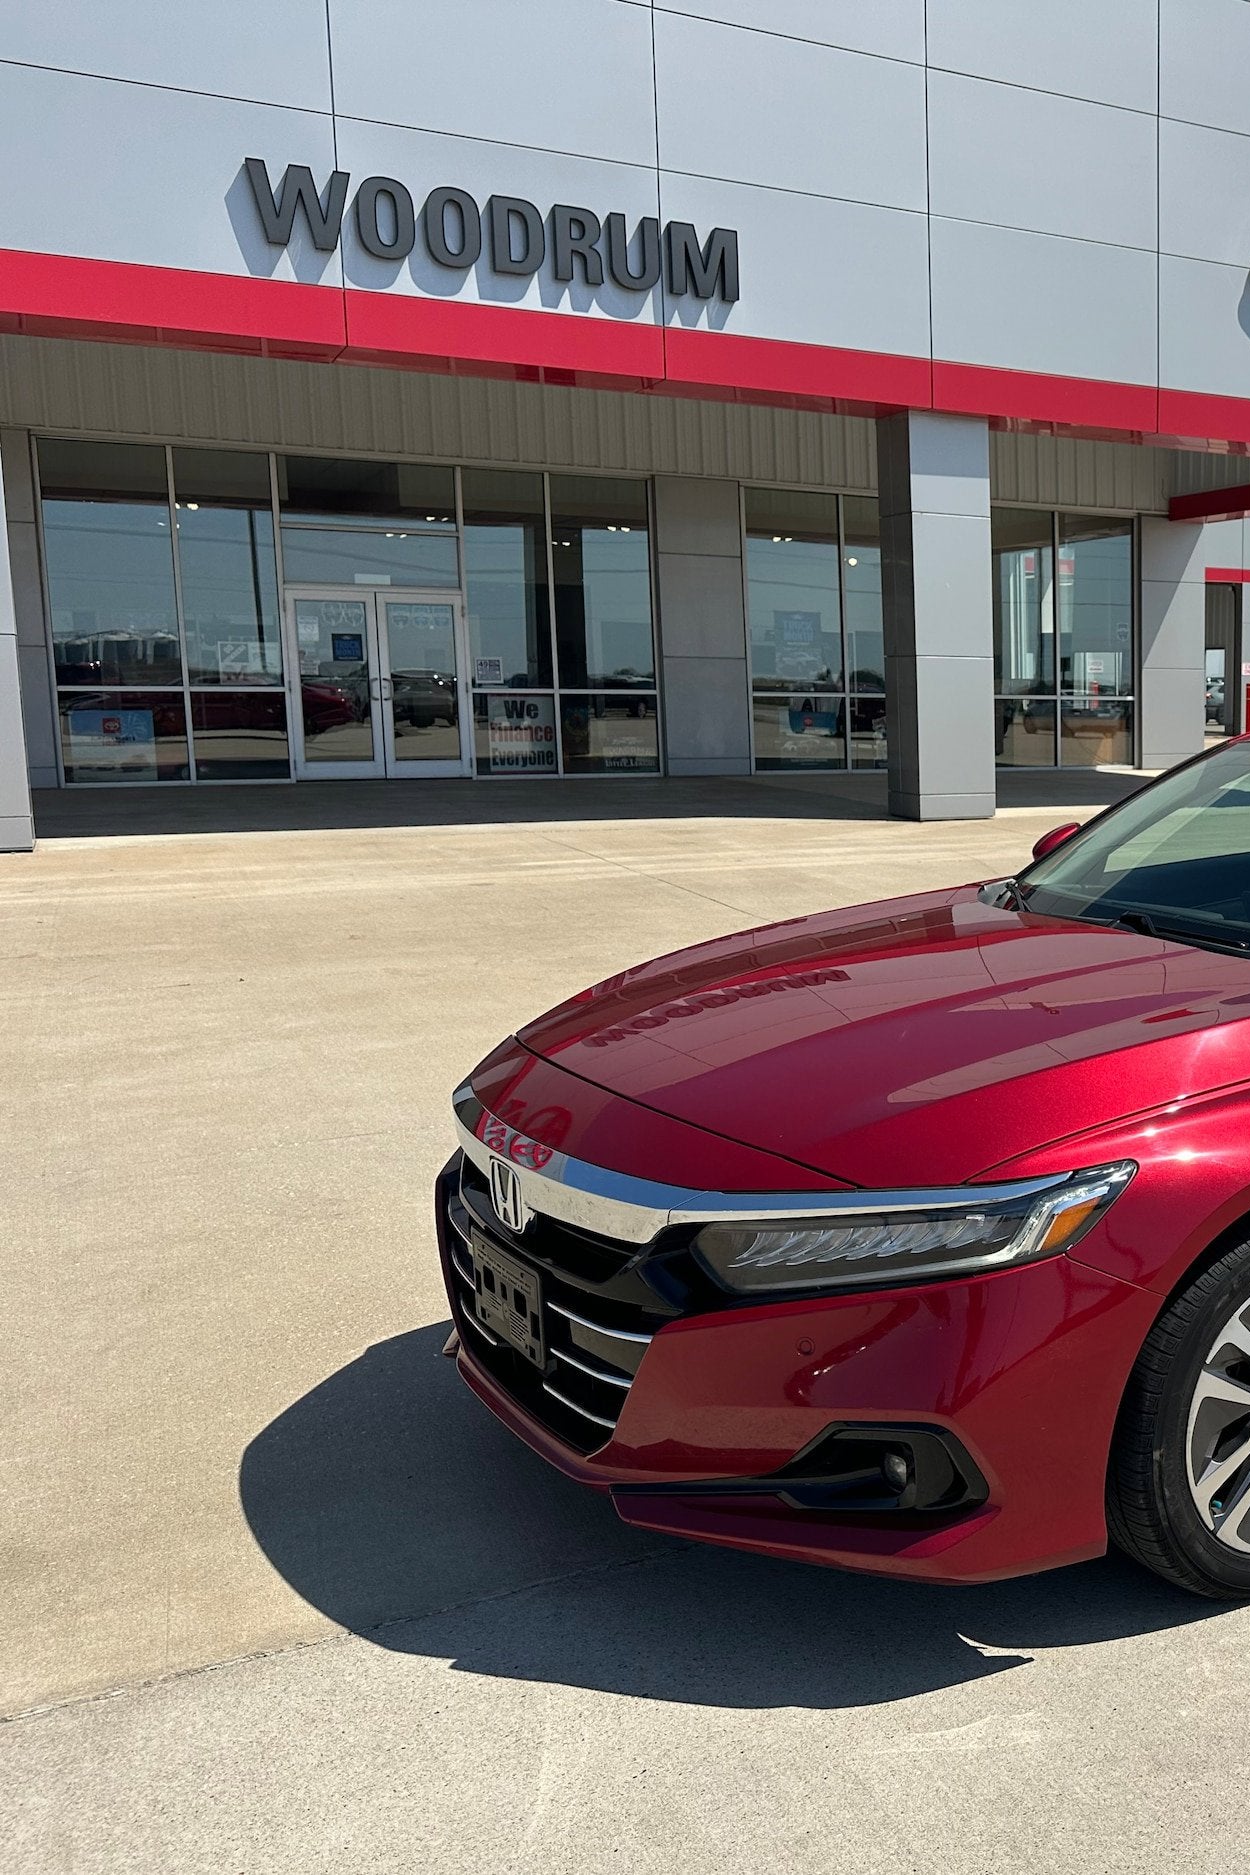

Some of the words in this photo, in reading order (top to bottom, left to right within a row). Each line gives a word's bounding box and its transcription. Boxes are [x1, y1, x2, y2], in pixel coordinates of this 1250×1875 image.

[244, 157, 740, 302] WOODRUM
[503, 700, 539, 720] We
[490, 721, 554, 743] Finance
[491, 748, 554, 768] Everyone
